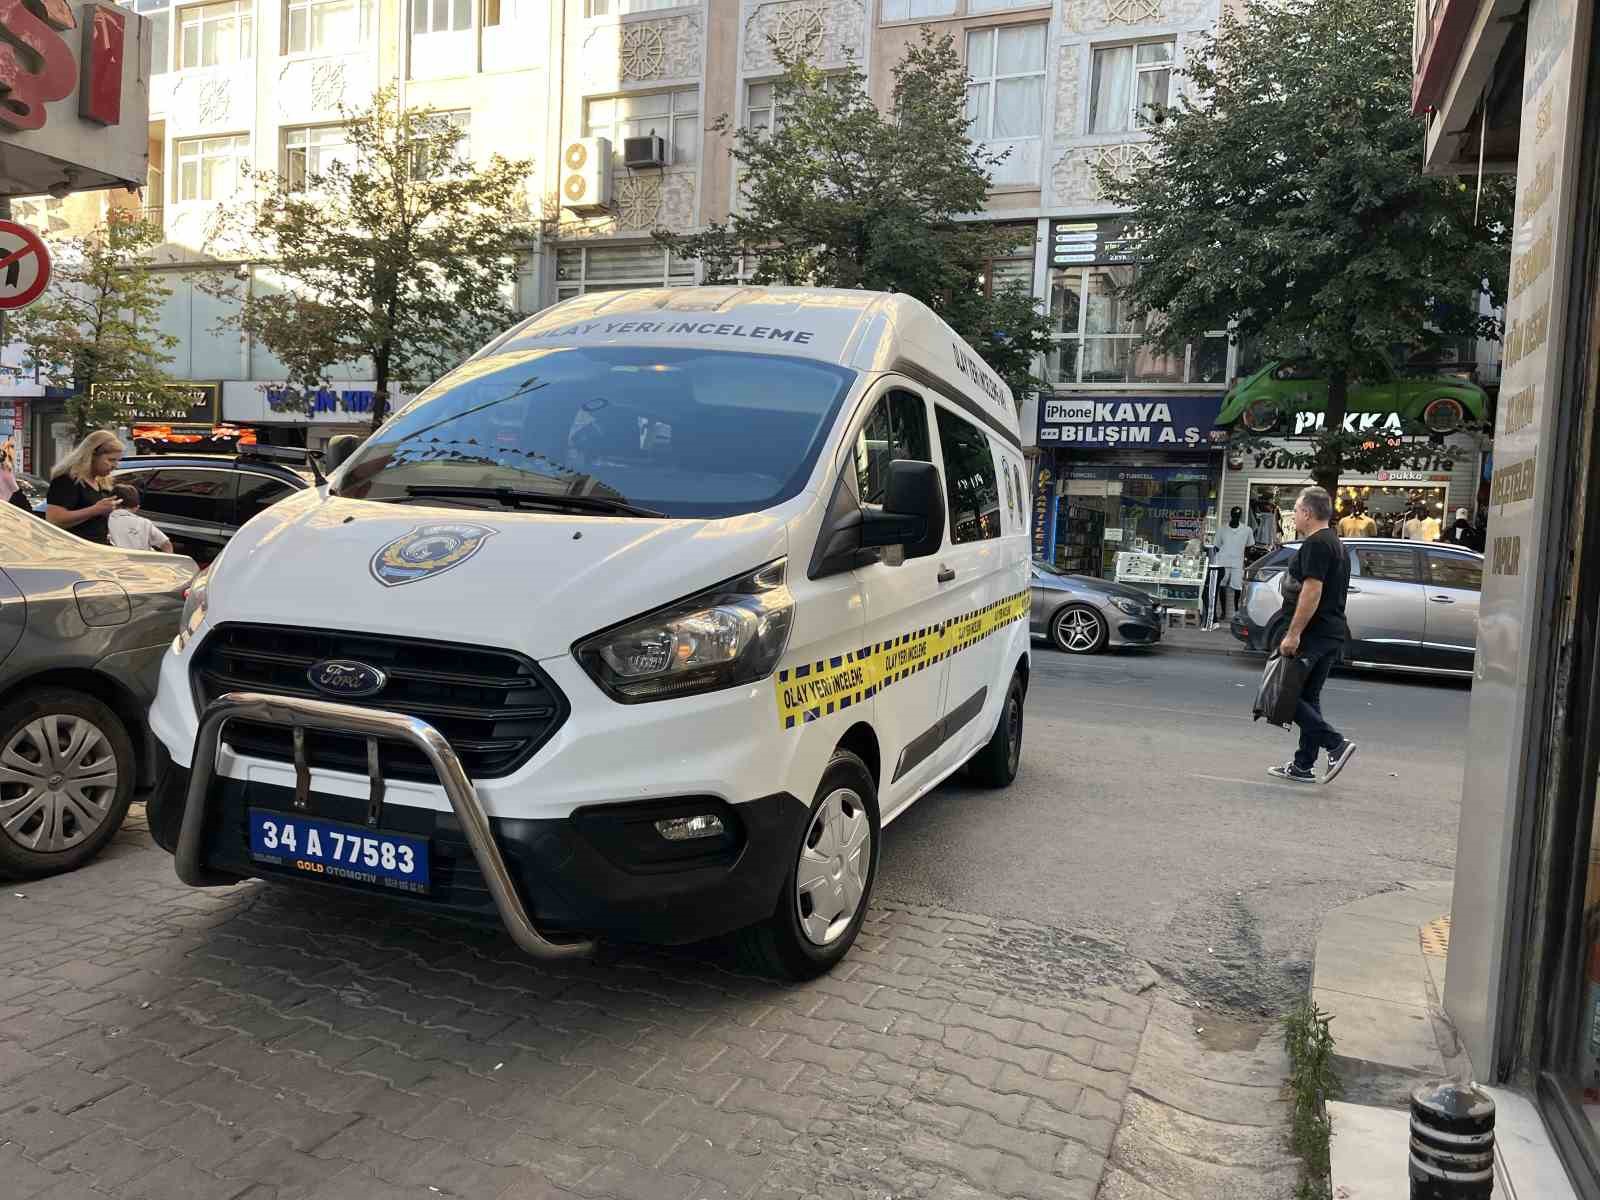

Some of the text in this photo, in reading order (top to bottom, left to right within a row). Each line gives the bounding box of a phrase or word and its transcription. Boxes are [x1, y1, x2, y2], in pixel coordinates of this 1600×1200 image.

[1047, 402, 1172, 422] iPhone KAYA
[1157, 427, 1207, 447] A.Ş.
[320, 664, 365, 689] Ford
[783, 683, 810, 710] OLAY
[262, 821, 415, 874] 34 A 77583
[296, 860, 324, 873] GOLD
